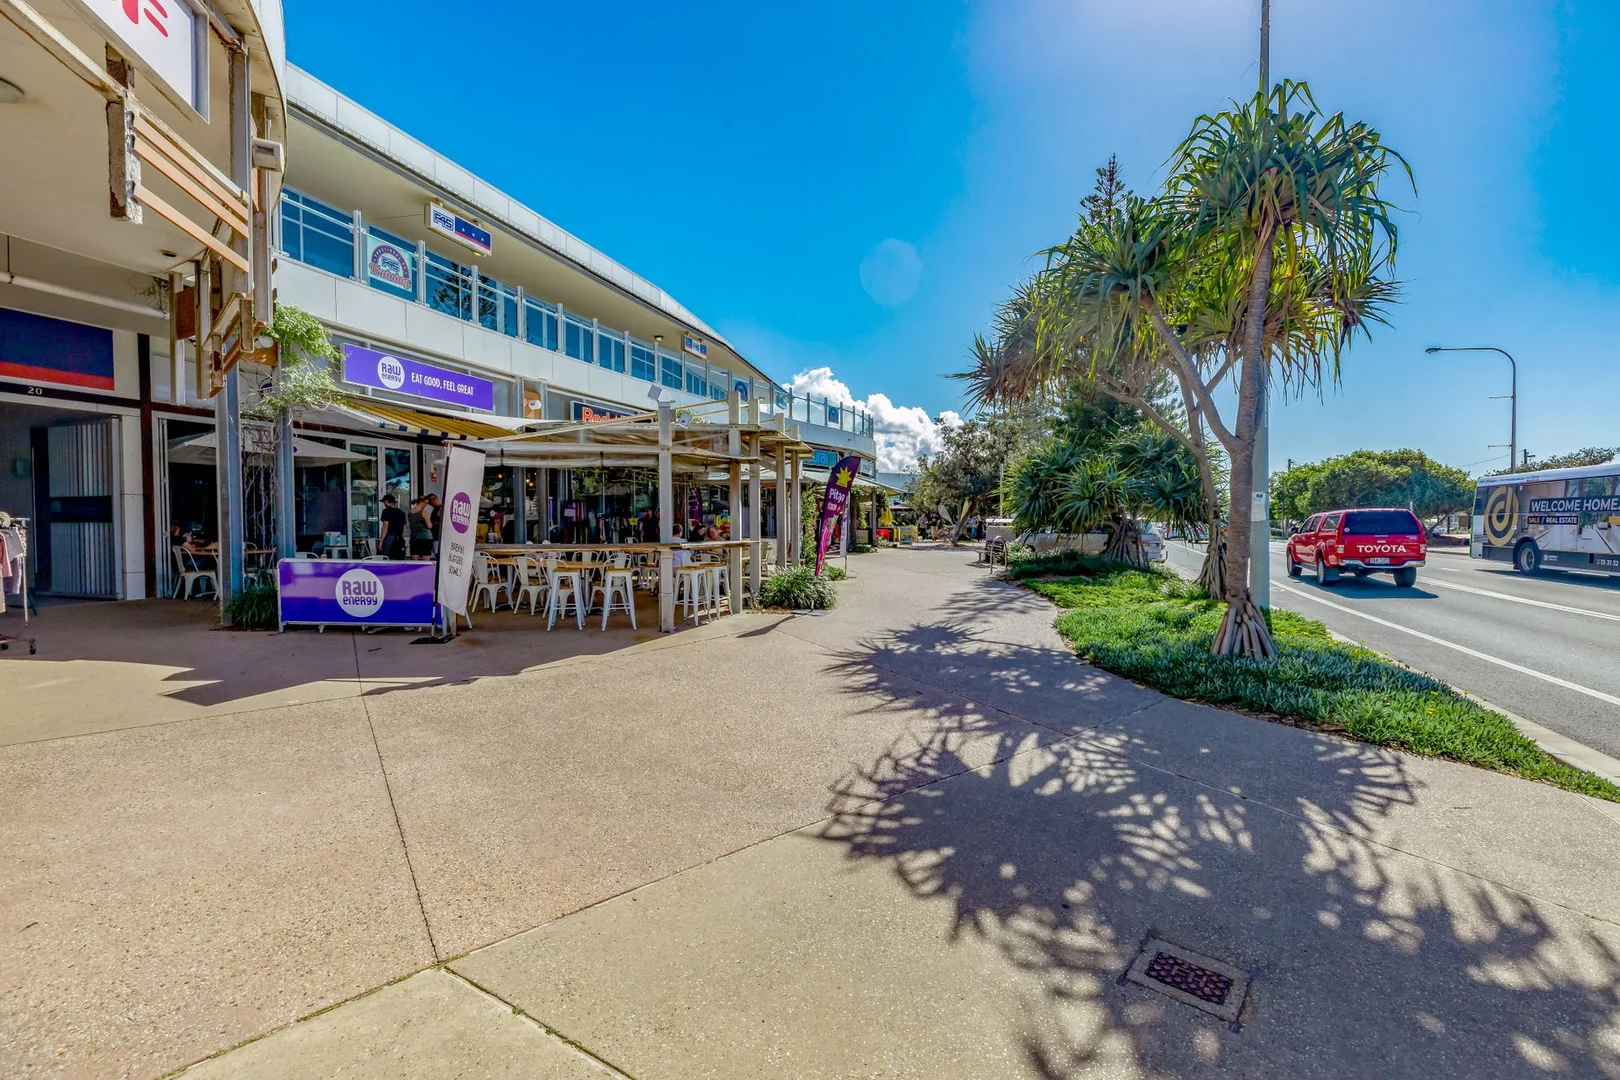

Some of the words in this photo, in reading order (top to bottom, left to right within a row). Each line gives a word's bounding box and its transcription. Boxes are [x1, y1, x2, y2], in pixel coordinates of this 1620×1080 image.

[433, 210, 454, 231] F45
[27, 386, 43, 395] 20
[411, 372, 423, 385] EAT
[424, 376, 443, 389] GOOD,
[443, 380, 456, 392] FEEL
[457, 383, 474, 396] GREAT
[1531, 499, 1581, 512] WELCOME
[1356, 544, 1407, 553] TOYOTA
